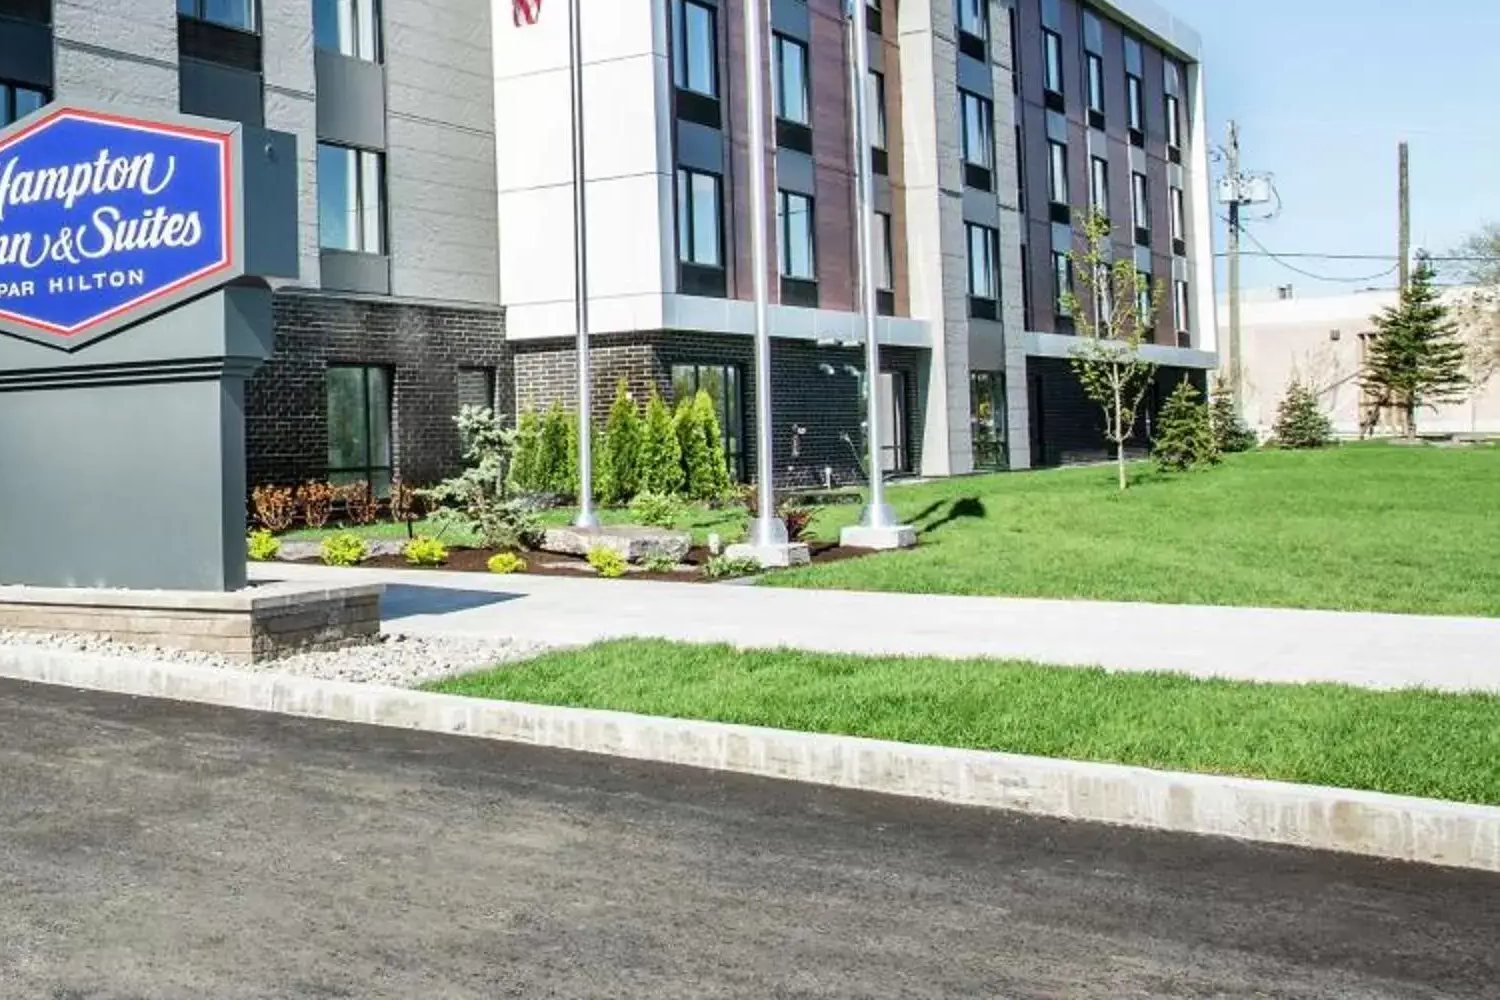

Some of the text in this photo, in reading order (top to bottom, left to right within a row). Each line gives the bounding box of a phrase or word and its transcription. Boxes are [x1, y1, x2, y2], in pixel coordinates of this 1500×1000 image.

[51, 226, 80, 265] &
[76, 206, 202, 259] Suites
[49, 268, 145, 294] HILTON
